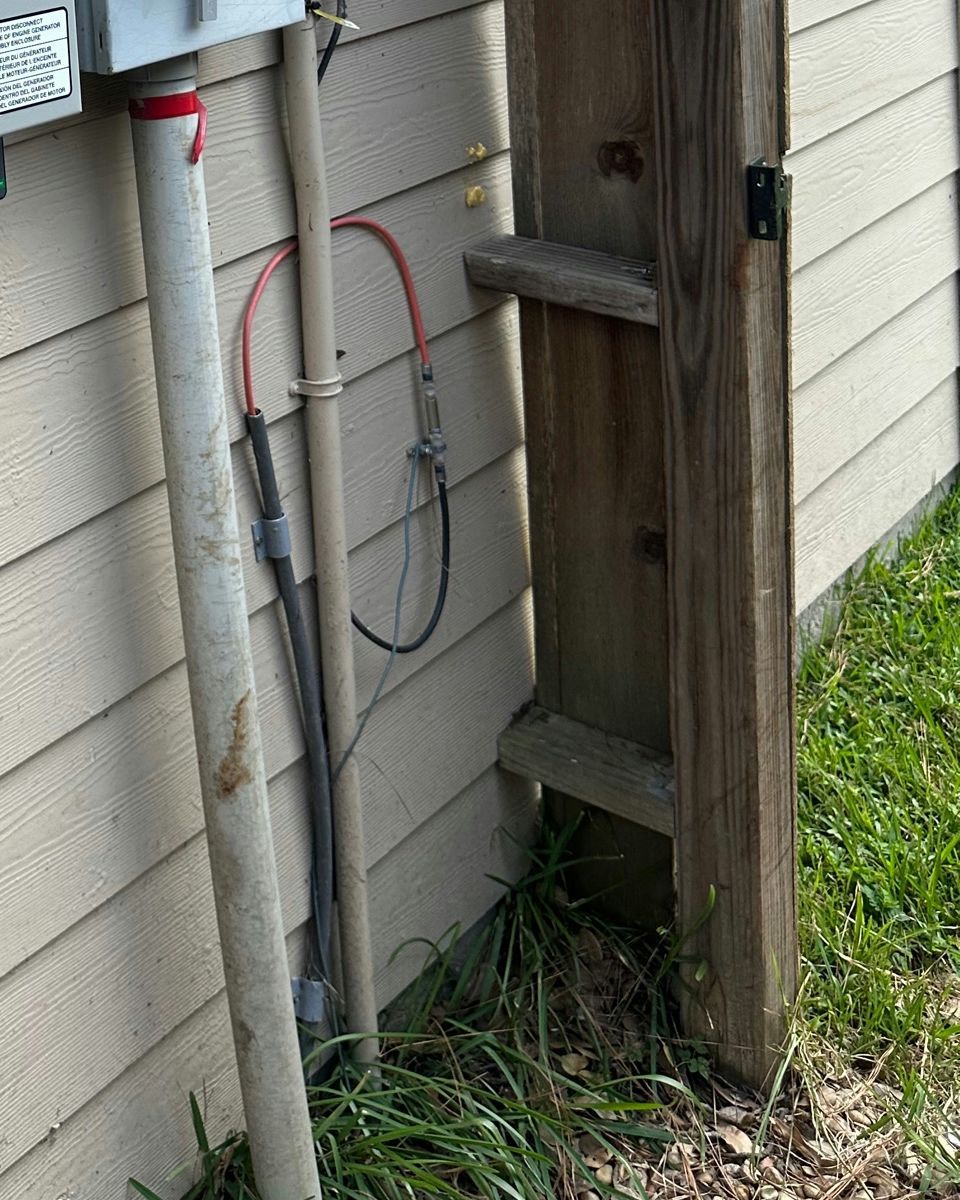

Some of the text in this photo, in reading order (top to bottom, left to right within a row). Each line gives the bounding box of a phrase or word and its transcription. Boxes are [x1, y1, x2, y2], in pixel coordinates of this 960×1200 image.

[11, 18, 43, 30] DISCONNECT
[12, 29, 30, 38] ENGINE
[31, 22, 60, 34] GENERATOR
[11, 34, 41, 46] ENCLOSURE
[12, 82, 22, 90] DEL
[23, 74, 53, 87] GENERADOR
[20, 88, 30, 96] DEL
[31, 81, 55, 93] GABINETE
[8, 93, 39, 107] GENERADOR
[40, 91, 47, 99] DE
[48, 86, 65, 97] MOTOR
